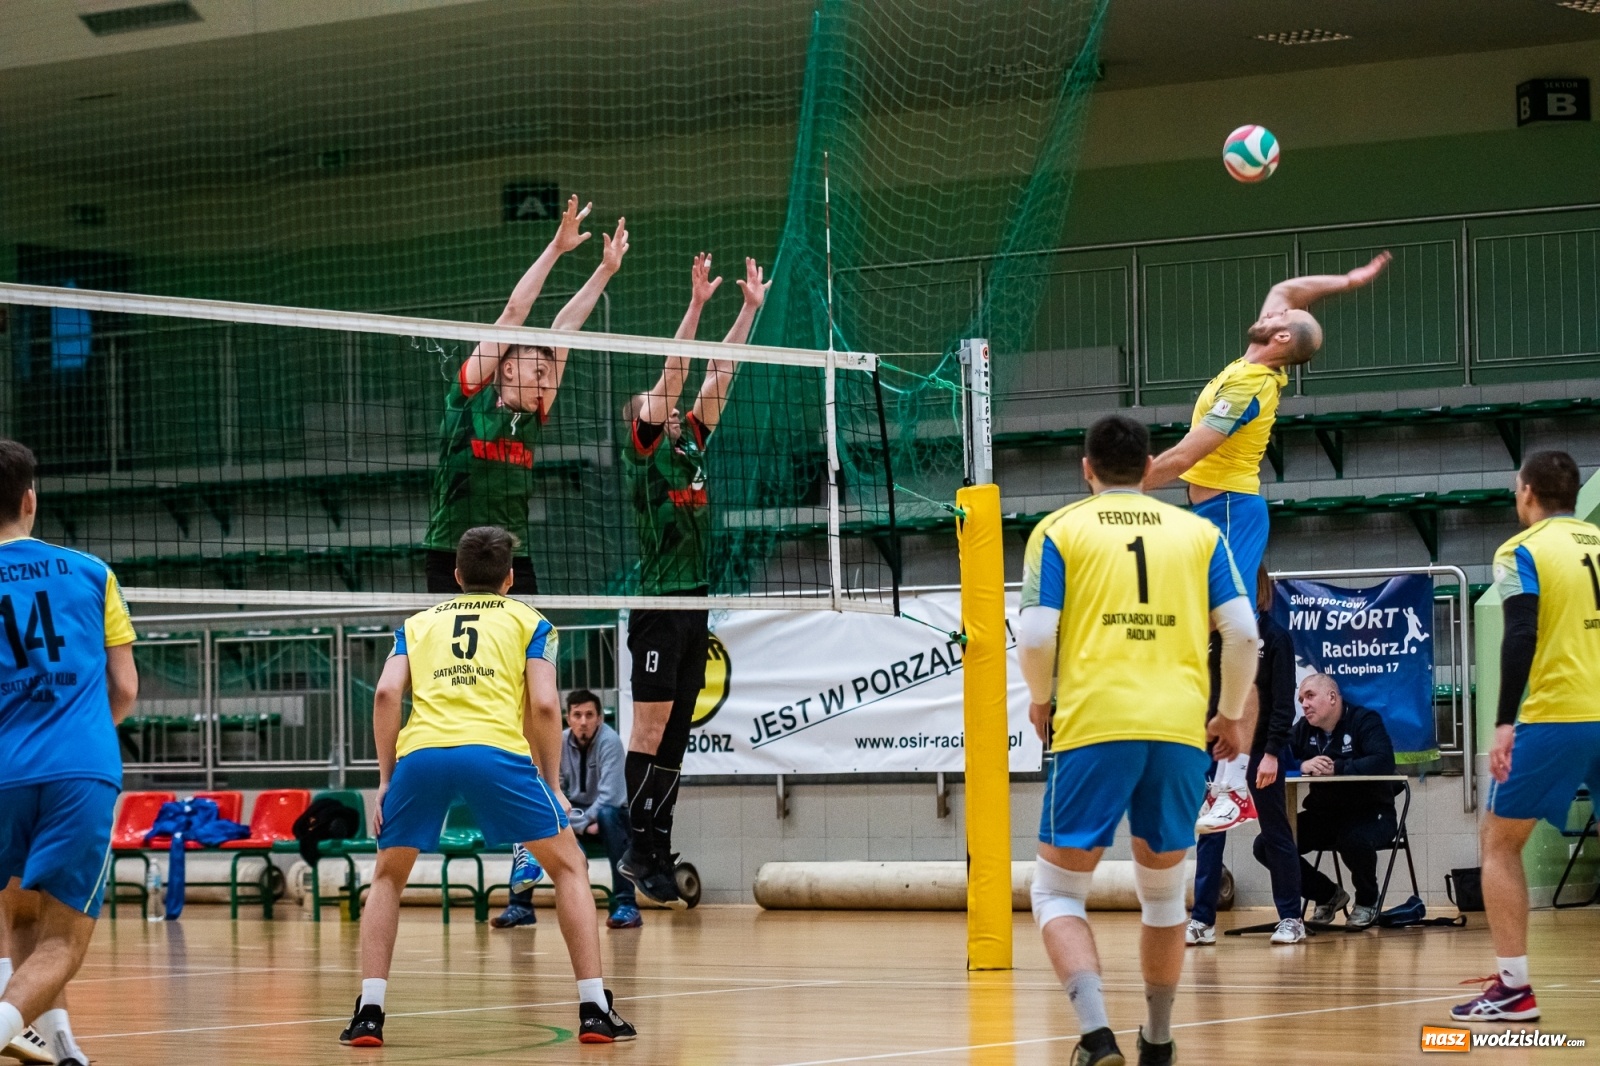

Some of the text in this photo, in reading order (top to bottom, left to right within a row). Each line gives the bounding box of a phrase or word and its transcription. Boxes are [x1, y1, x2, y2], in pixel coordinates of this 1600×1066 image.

[1520, 95, 1531, 120] B
[1547, 93, 1577, 116] B
[516, 196, 548, 217] A
[1097, 511, 1162, 526] FERDYAN
[56, 558, 73, 576] D.
[1126, 536, 1149, 605] 1
[1580, 553, 1600, 611] 1
[435, 600, 506, 614] SZAFRANEK
[1290, 594, 1368, 609] Sklep sportowy
[0, 590, 66, 669] 14
[1102, 612, 1175, 627] SIATKARSKI KLUB
[1288, 607, 1399, 631] MW SPORT
[451, 614, 481, 660] 5
[1126, 628, 1156, 640] RADLIN
[1322, 638, 1400, 658] Racibórz
[645, 650, 660, 673] 13
[1324, 662, 1399, 677] ul. Chopina 17
[55, 672, 78, 687] KLUB
[451, 675, 477, 686] RADLIN
[749, 697, 812, 745] JEST
[819, 684, 845, 716] W
[686, 730, 735, 753] BÓRZ
